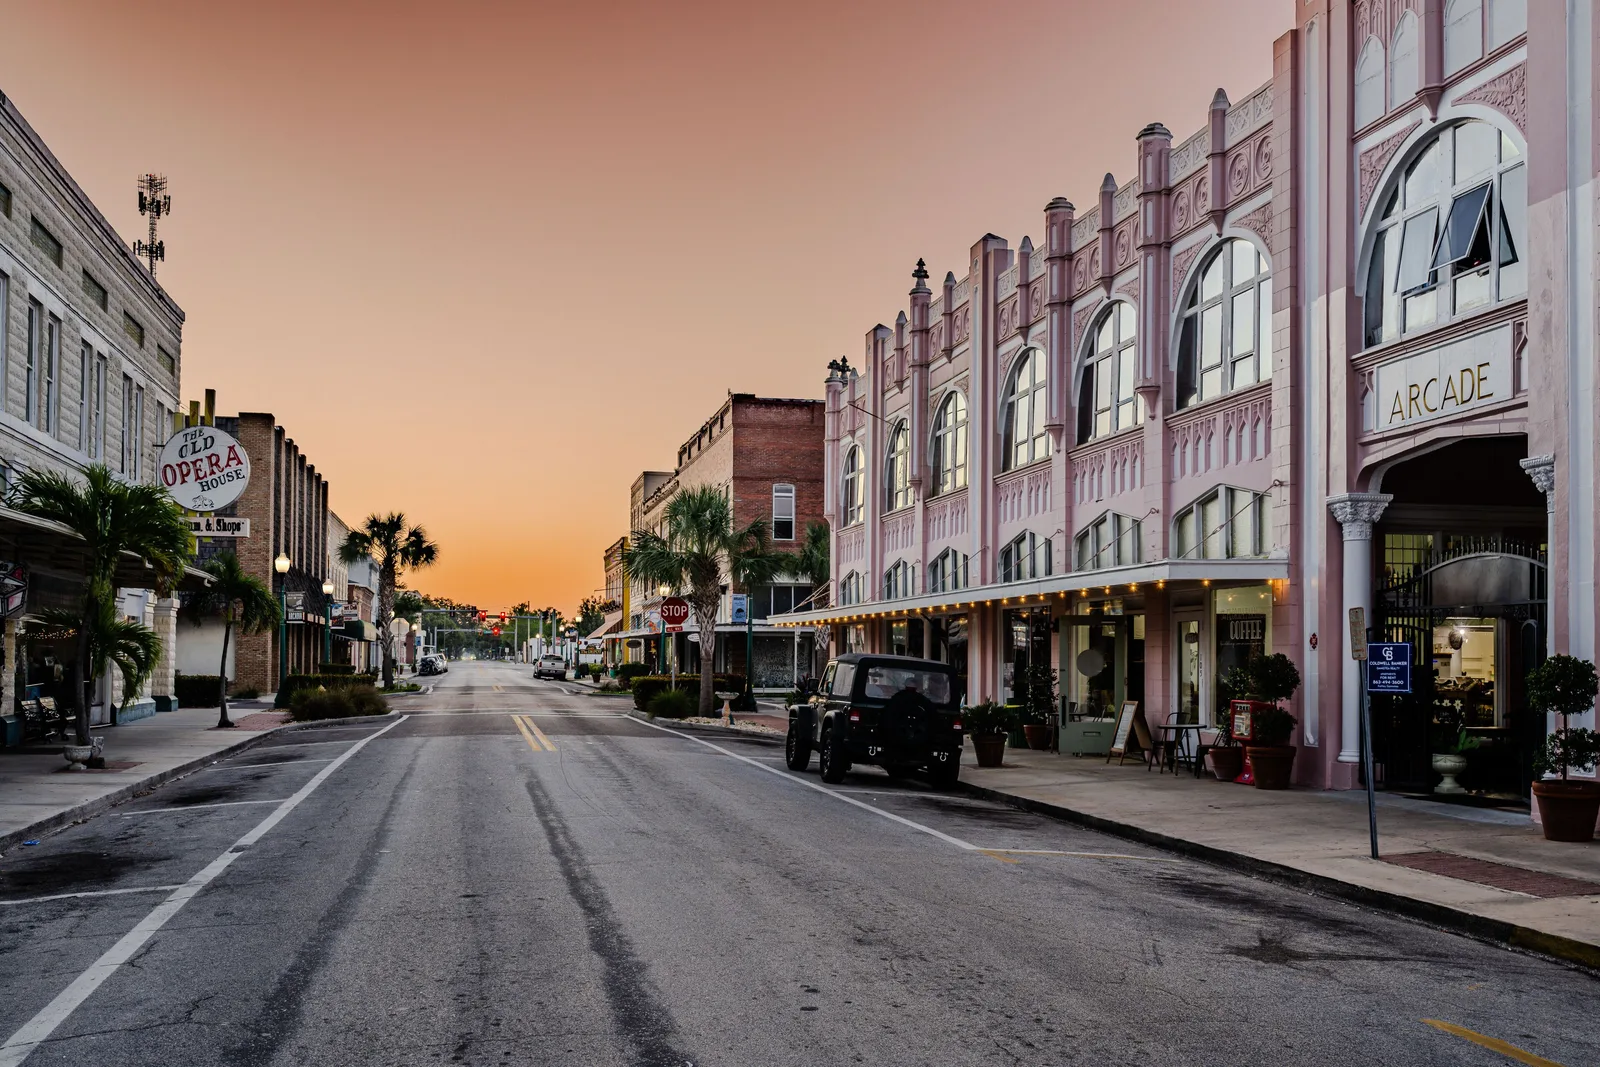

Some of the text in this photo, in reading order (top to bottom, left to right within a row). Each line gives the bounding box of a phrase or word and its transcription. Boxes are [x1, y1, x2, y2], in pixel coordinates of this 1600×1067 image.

[1388, 362, 1494, 424] ARCADE
[182, 428, 205, 443] THE
[178, 435, 215, 458] OLD
[161, 444, 243, 487] OPERA
[198, 468, 245, 492] HOUSE
[216, 518, 241, 535] Shops
[662, 605, 688, 617] STOP
[1230, 620, 1262, 640] COFFEE
